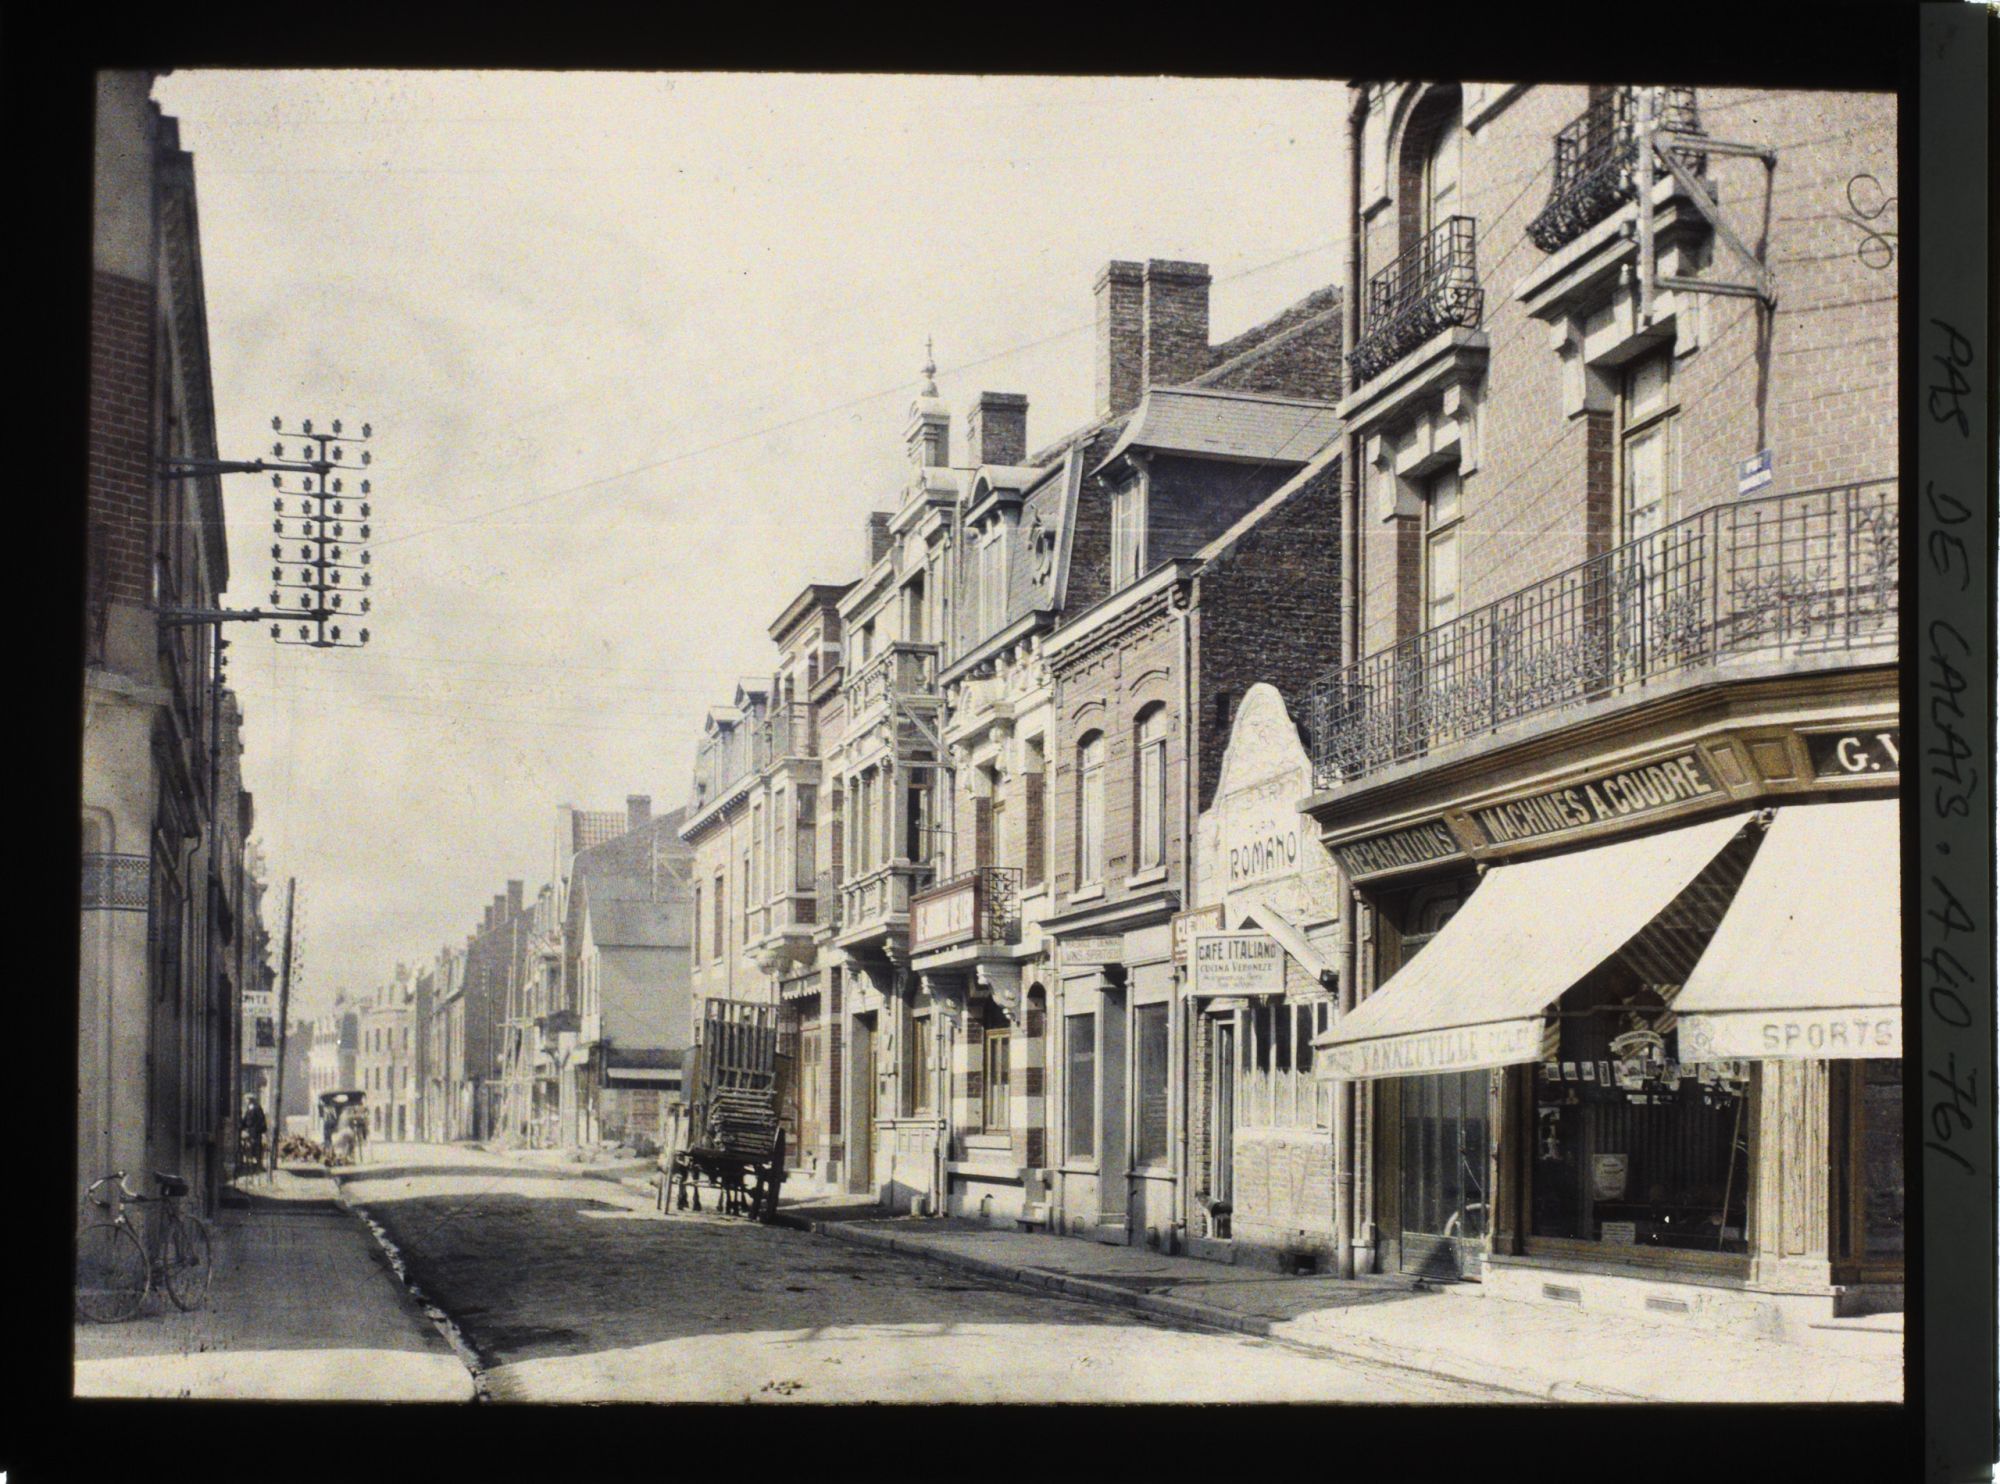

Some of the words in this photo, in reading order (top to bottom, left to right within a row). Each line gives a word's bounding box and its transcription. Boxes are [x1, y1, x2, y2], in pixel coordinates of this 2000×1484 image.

[1929, 317, 1974, 438] PAS
[1927, 480, 1972, 591] DE
[1479, 789, 1591, 842] MACHINES
[1584, 784, 1614, 820] A
[1602, 755, 1712, 814] COUDRE
[1229, 831, 1297, 880] ROMANO
[1340, 823, 1456, 875] REPARATIONS
[1199, 941, 1223, 960] CAFE
[1228, 940, 1277, 960] ITALIANO
[1763, 1018, 1894, 1050] SPORTS
